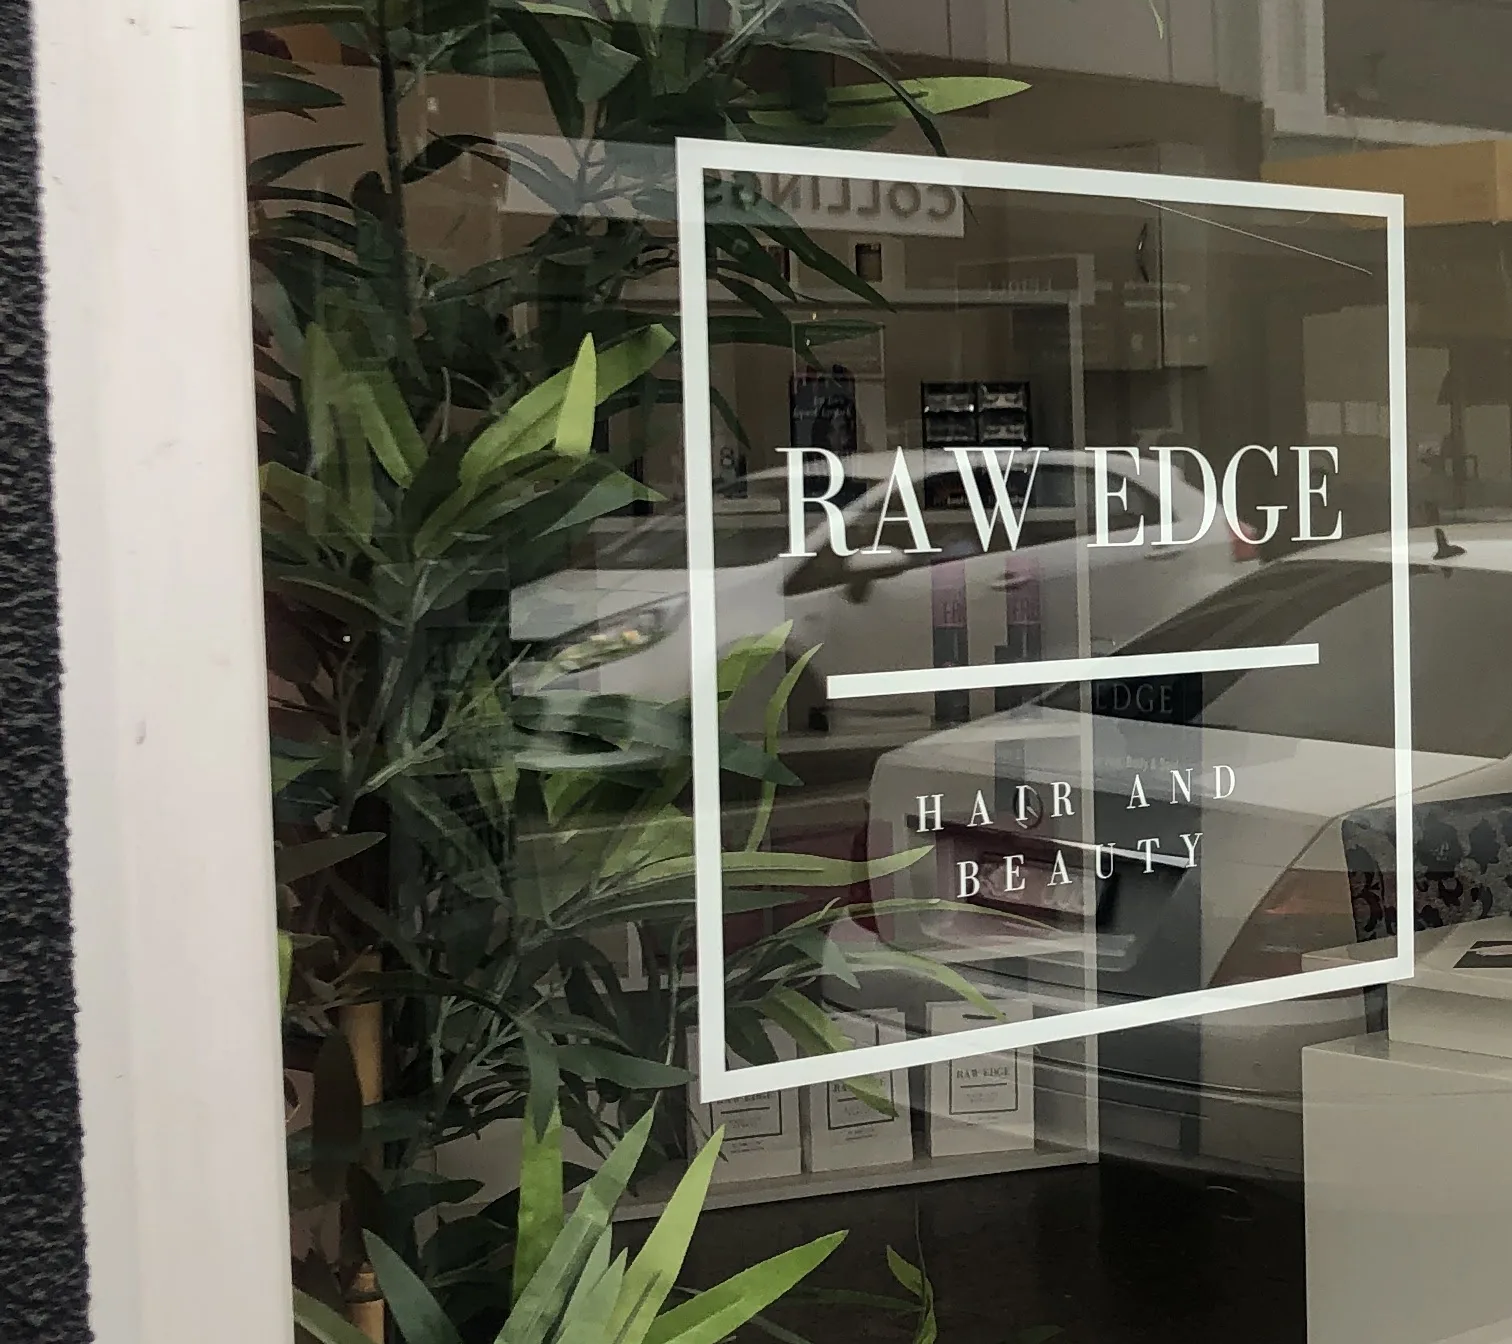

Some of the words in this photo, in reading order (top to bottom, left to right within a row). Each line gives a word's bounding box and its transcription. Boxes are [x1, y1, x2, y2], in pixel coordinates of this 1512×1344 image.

[775, 446, 1050, 558] RAW
[1084, 445, 1343, 549] EDGE
[915, 781, 1075, 833] HAIR
[1126, 764, 1237, 810] AND
[956, 832, 1204, 898] BEAUTY
